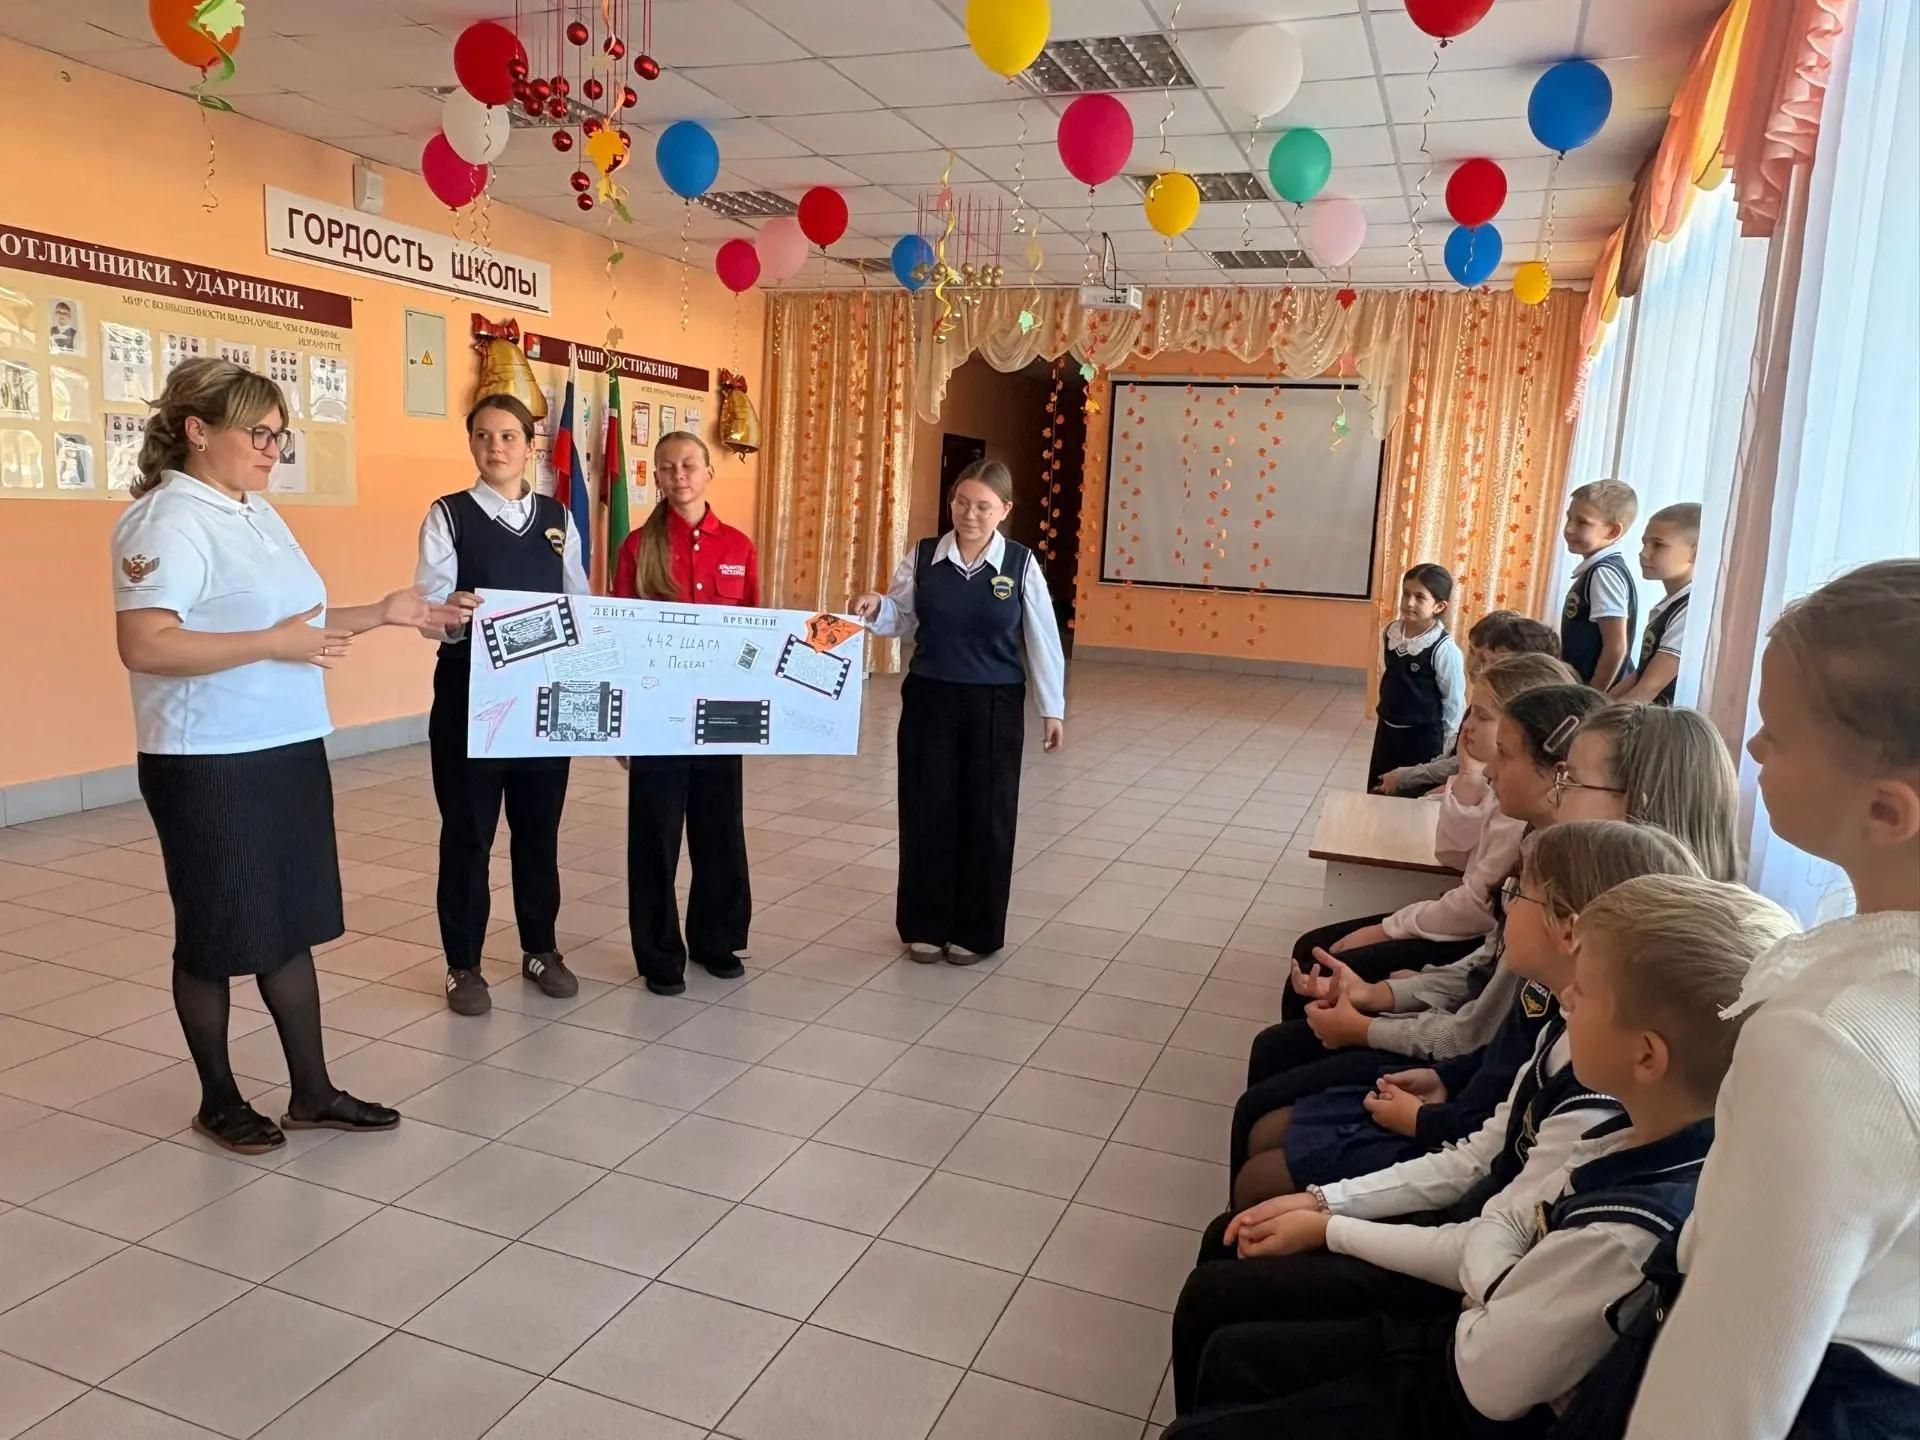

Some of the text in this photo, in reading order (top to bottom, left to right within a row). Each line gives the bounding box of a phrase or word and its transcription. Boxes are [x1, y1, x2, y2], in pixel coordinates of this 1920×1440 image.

[0, 233, 304, 310] ОТЛИЧНИКИ. УДАРНИКИ.
[288, 207, 537, 297] ГОРДОСТЬ ШКОЛЫ
[592, 607, 777, 627] ЛЕНТА ВРЕМЕНИ
[646, 632, 721, 651] 442 ШАГА
